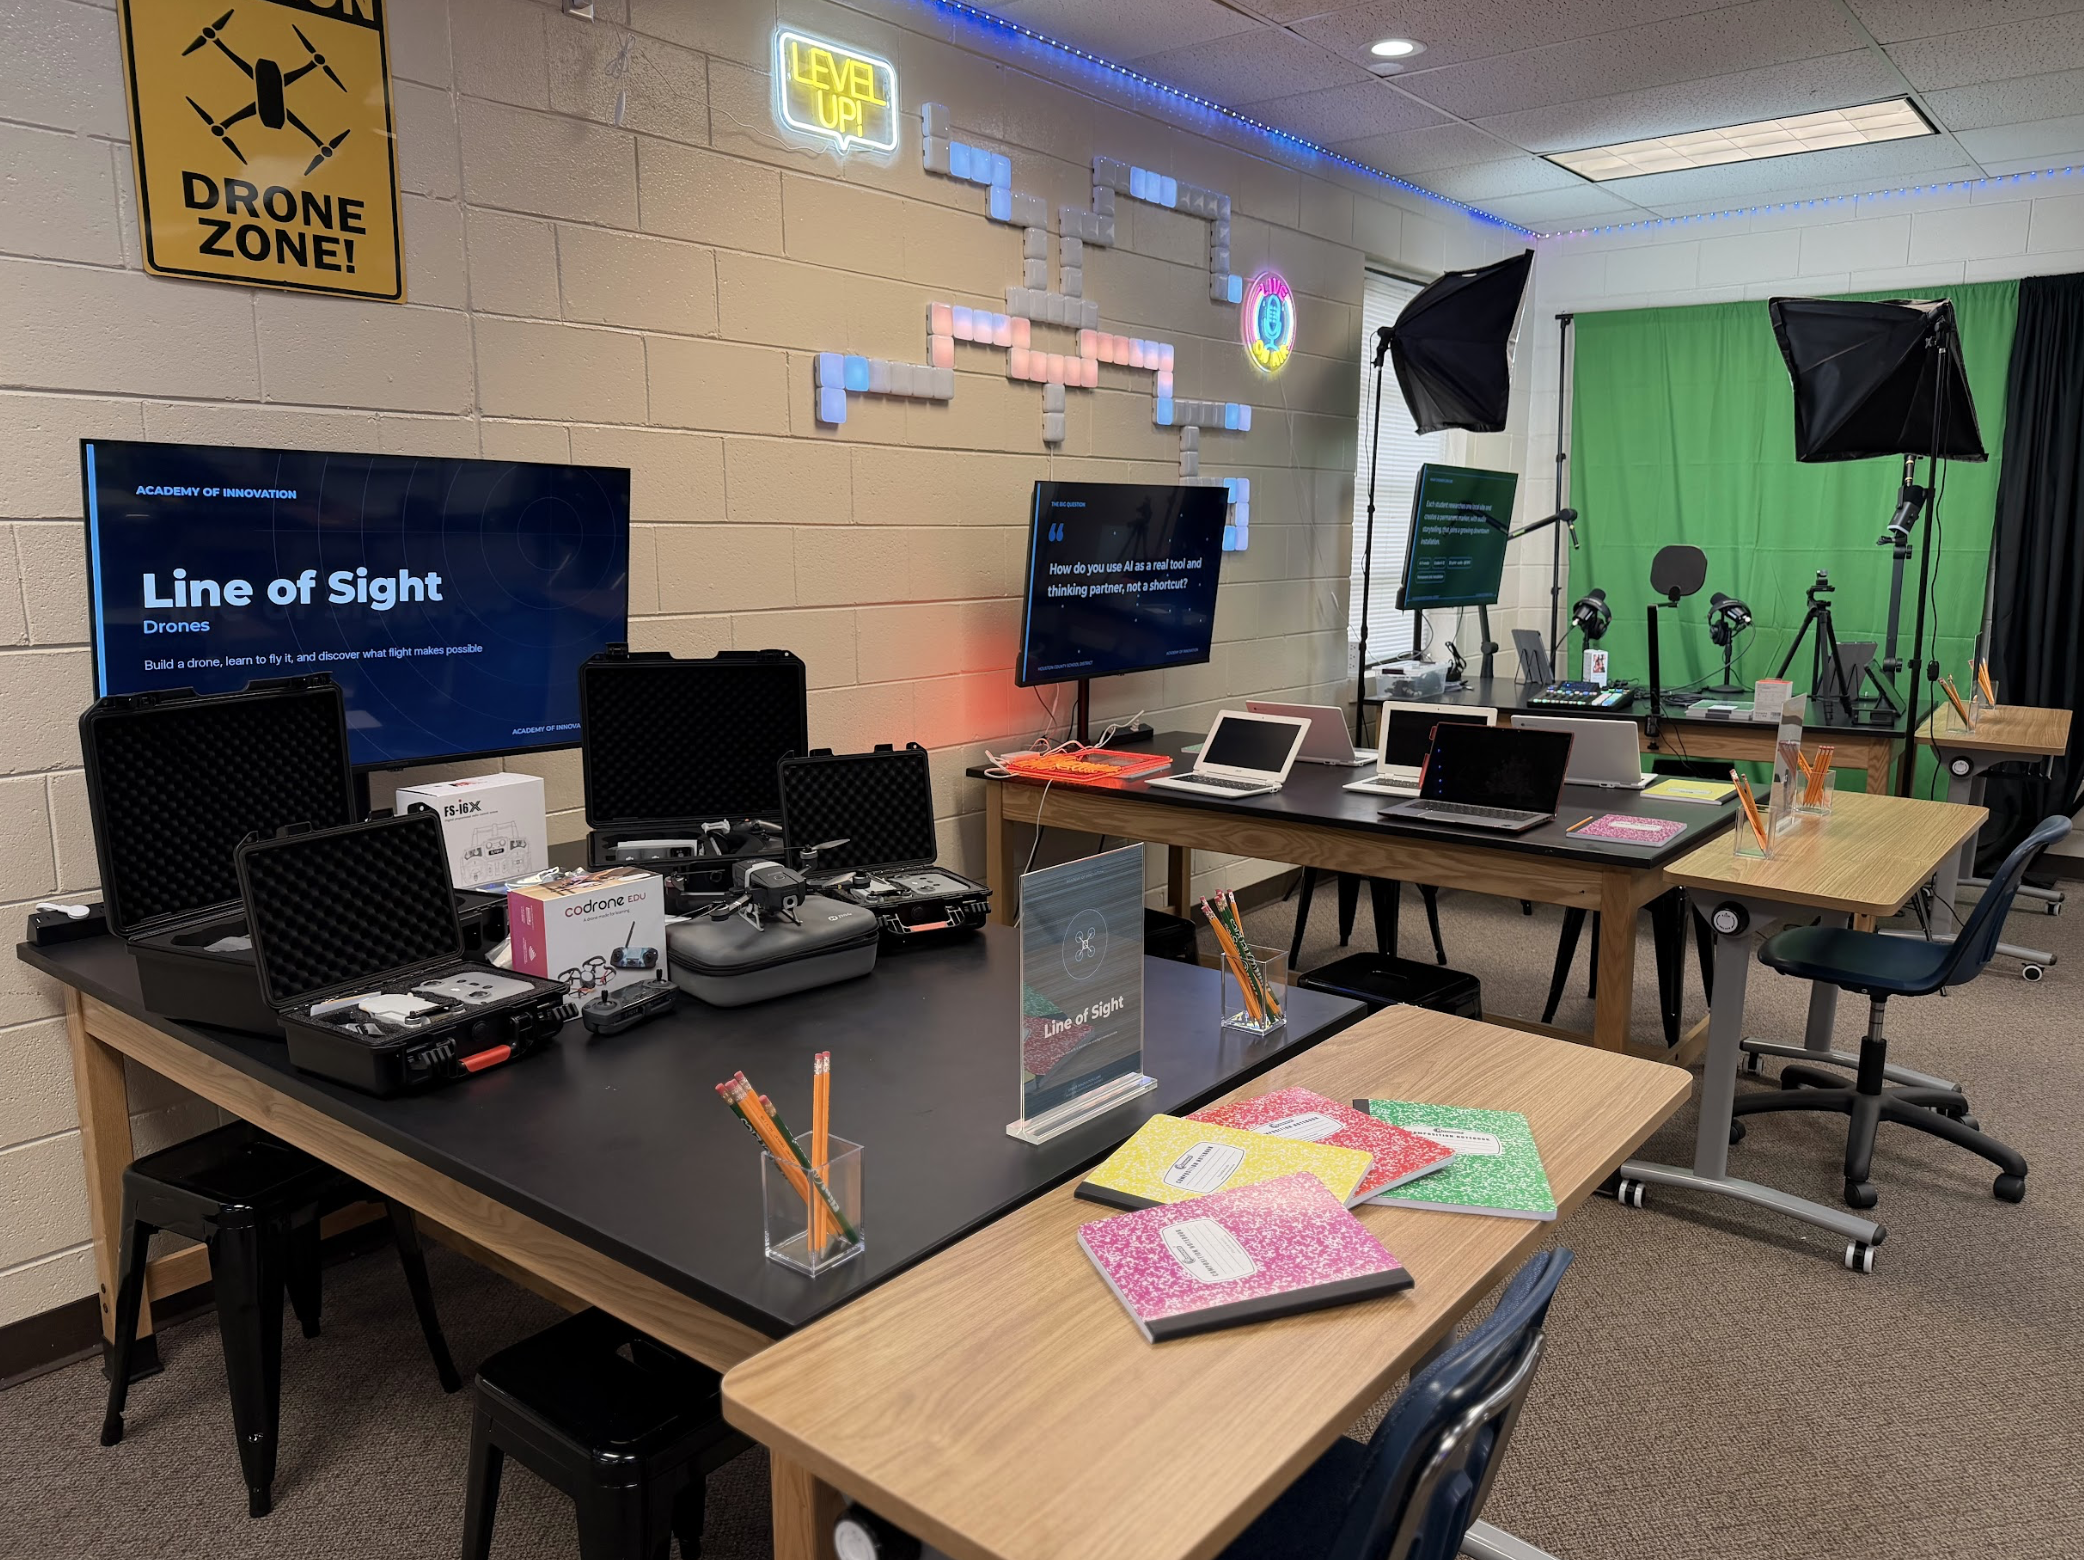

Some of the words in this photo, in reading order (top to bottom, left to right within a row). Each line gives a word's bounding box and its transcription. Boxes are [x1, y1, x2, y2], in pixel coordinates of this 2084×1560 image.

[791, 41, 887, 106] LEVEL
[818, 89, 863, 137] UP!
[181, 170, 367, 235] DRONE
[198, 217, 356, 274] ZONE!
[136, 485, 200, 498] ACADEMY
[202, 487, 220, 498] OF
[223, 488, 298, 500] INNOVATION
[1049, 562, 1072, 575] How
[1073, 561, 1086, 574] do
[1087, 563, 1105, 577] you
[1106, 562, 1122, 573] use
[1123, 560, 1134, 572] AI
[1134, 561, 1145, 572] as
[1146, 561, 1151, 571] a
[1153, 558, 1168, 571] real
[1170, 558, 1186, 570] tool
[1187, 557, 1202, 569] and
[142, 567, 254, 609] Line
[266, 568, 317, 606] of
[327, 566, 444, 612] Sight
[1047, 583, 1087, 598] thinking
[1089, 582, 1125, 597] partner,
[1126, 581, 1142, 592] not
[1142, 582, 1148, 591] a
[1149, 578, 1188, 591] shortcut?
[143, 619, 211, 635] Drones
[144, 659, 174, 671] Build
[177, 660, 185, 669] a
[187, 657, 223, 668] drone,
[225, 655, 253, 667] learn
[255, 654, 267, 665] to
[269, 653, 282, 666] fly
[284, 652, 294, 664] it,
[296, 651, 316, 663] and
[318, 650, 360, 661] discover
[362, 648, 387, 659] what
[389, 647, 412, 659] flight
[413, 645, 444, 656] makes
[446, 643, 483, 657] possible
[511, 725, 545, 735] ACADEMY
[545, 724, 555, 732] OF
[555, 722, 582, 731] INNOVA
[444, 798, 482, 817] FS-i6X
[564, 895, 625, 918] codrone
[627, 892, 647, 903] EDU
[1044, 1017, 1073, 1039] Line
[1075, 1007, 1089, 1026] of
[1091, 995, 1124, 1019] Sight
[1192, 1248, 1219, 1277] COMPOSITION
